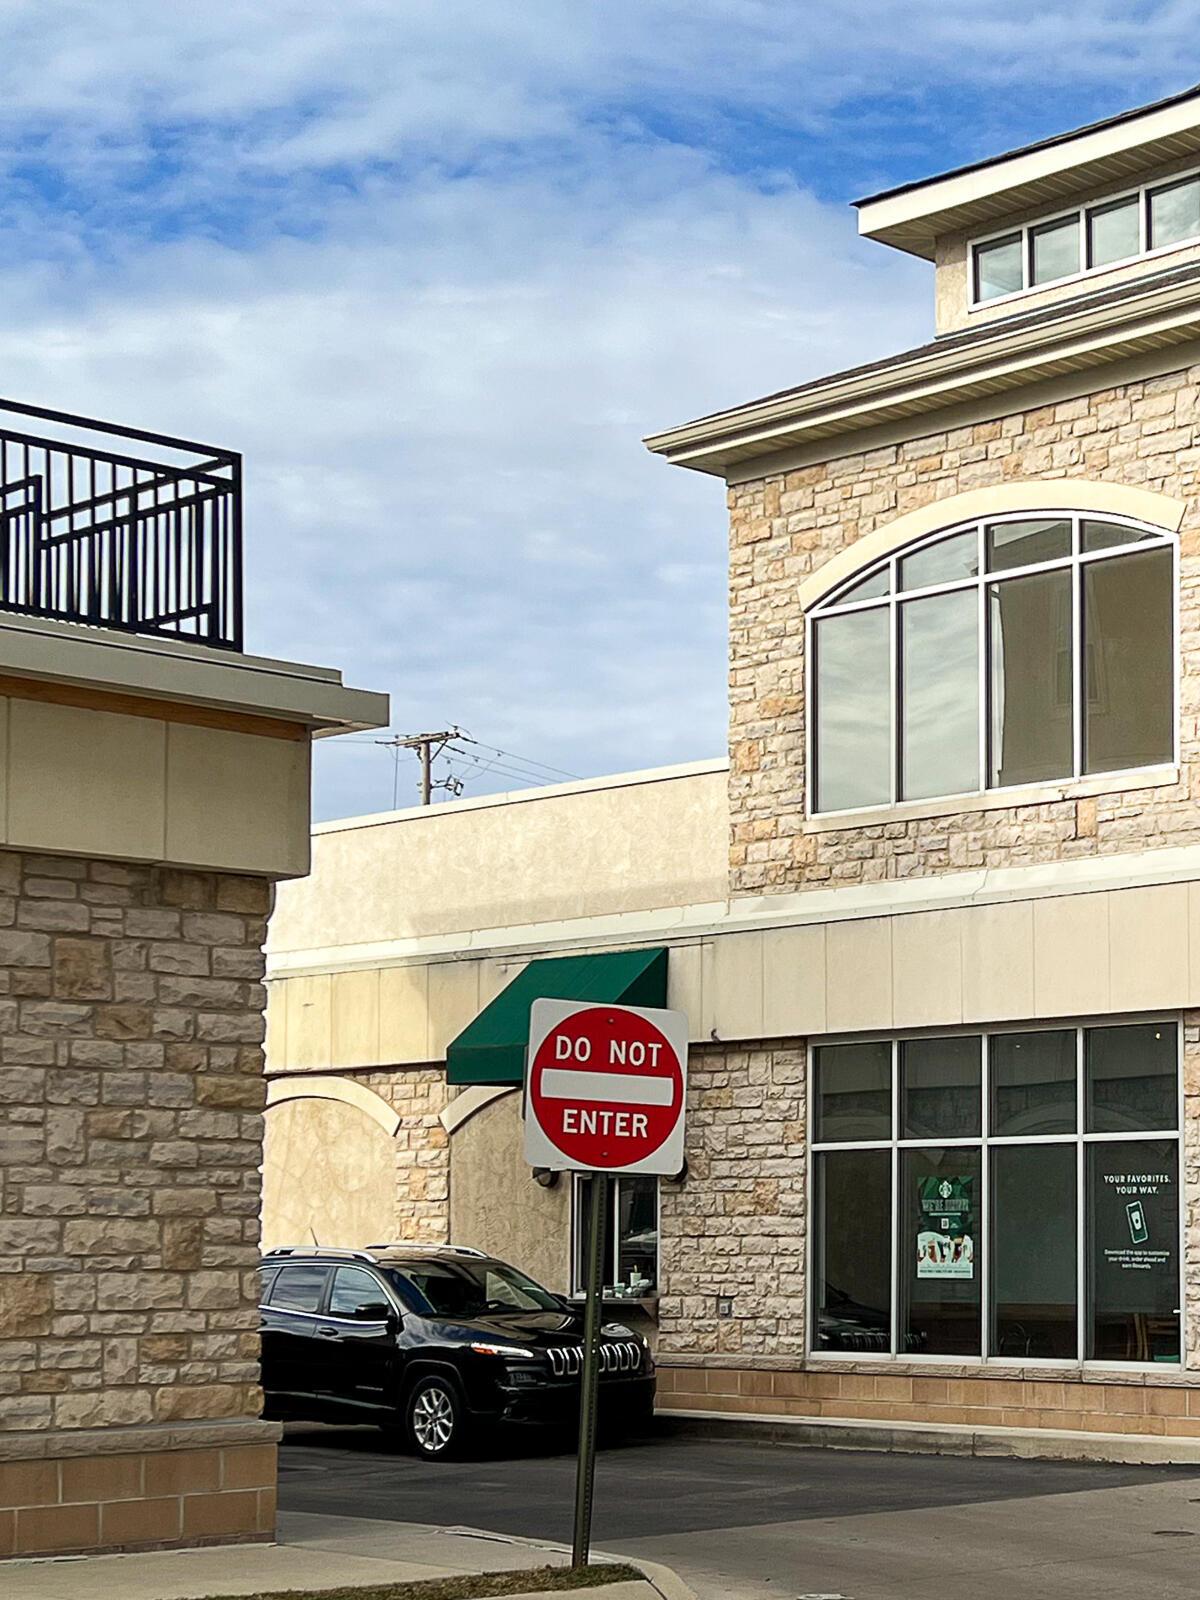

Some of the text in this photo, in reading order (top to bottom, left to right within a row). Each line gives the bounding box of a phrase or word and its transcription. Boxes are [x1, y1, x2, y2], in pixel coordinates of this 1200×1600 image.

[555, 1035, 663, 1068] DO NOT
[562, 1108, 649, 1138] ENTER
[1103, 1174, 1171, 1184] YOUR FAVORITES.
[1115, 1186, 1159, 1195] YOUR WAY.
